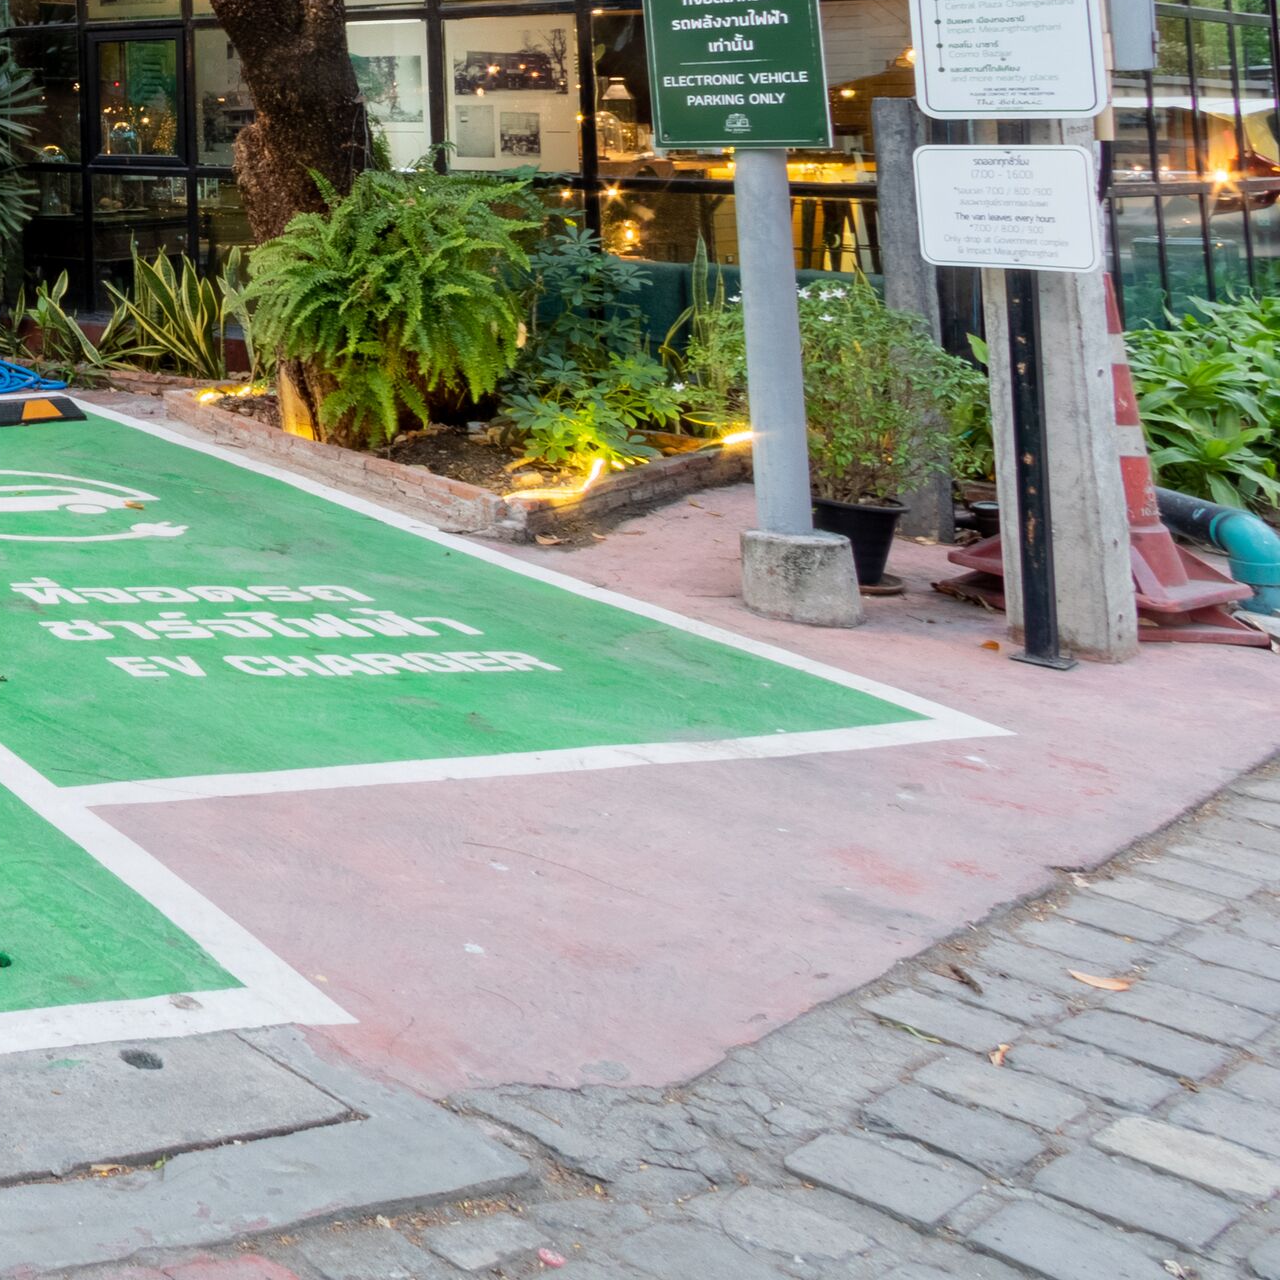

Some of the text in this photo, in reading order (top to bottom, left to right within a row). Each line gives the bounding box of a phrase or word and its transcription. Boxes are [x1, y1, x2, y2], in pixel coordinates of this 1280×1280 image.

[671, 9, 789, 31] รถพลังงานไฟฟ้า
[708, 33, 754, 53] เท่านั้น
[663, 71, 809, 88] ELECTRONIC VEHICLE
[687, 92, 786, 106] PARKING ONLY
[954, 211, 969, 220] The
[988, 213, 1013, 222] leaves
[1015, 215, 1034, 224] every
[1035, 214, 1056, 223] hours
[10, 577, 377, 604] ที่จอดรถ
[40, 608, 484, 641] ชาร์จไฟฟ้า
[105, 650, 564, 677] EV CHARGER
